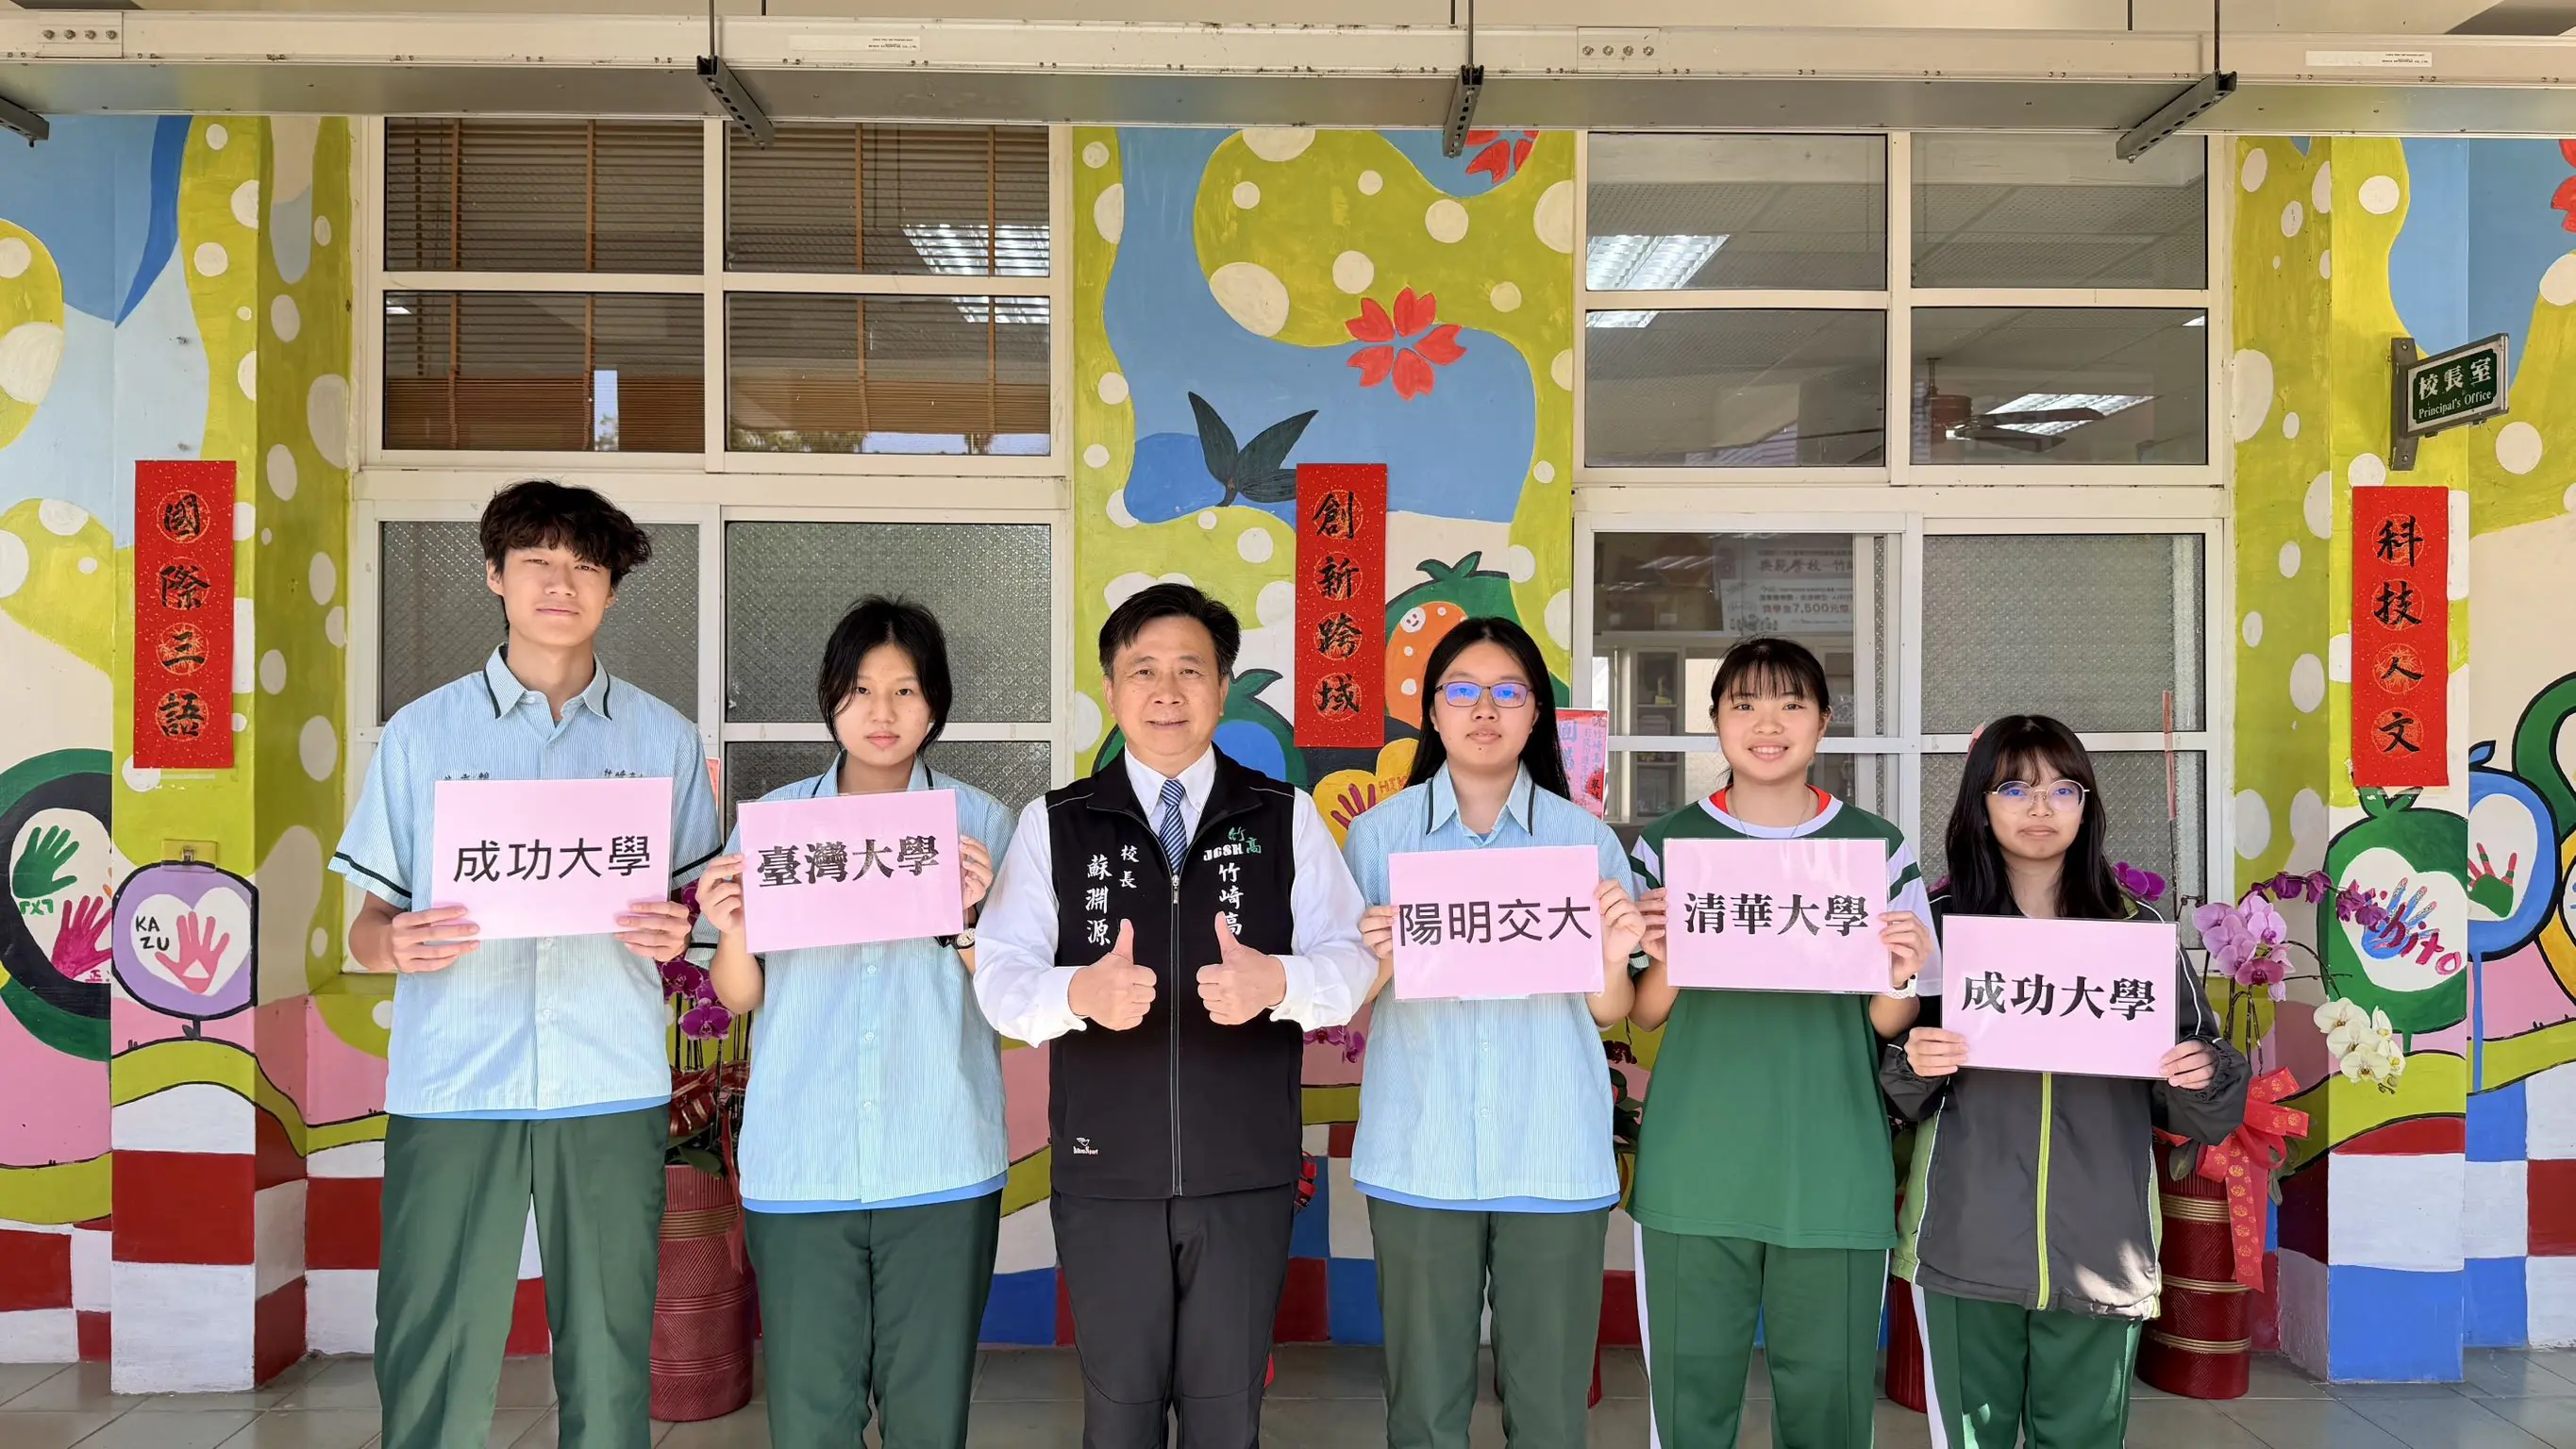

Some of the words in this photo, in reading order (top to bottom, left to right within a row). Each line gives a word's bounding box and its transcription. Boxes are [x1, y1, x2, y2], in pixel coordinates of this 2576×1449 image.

[2418, 357, 2492, 401] 校長室
[2418, 397, 2462, 419] Principal's
[2464, 391, 2492, 406] Office
[159, 493, 210, 738] 國際三語
[1313, 490, 1363, 713] 創新跨域
[2373, 515, 2425, 753] 科技人文
[453, 835, 651, 883] 成功大學
[757, 835, 939, 888] 臺灣大學
[1119, 844, 1140, 889] 校長
[135, 915, 160, 932] KA
[1398, 896, 1592, 947] 陽明交大
[1684, 892, 1868, 937] 清華大學
[140, 936, 170, 951] ZU
[1962, 971, 2156, 1021] 成功大學
